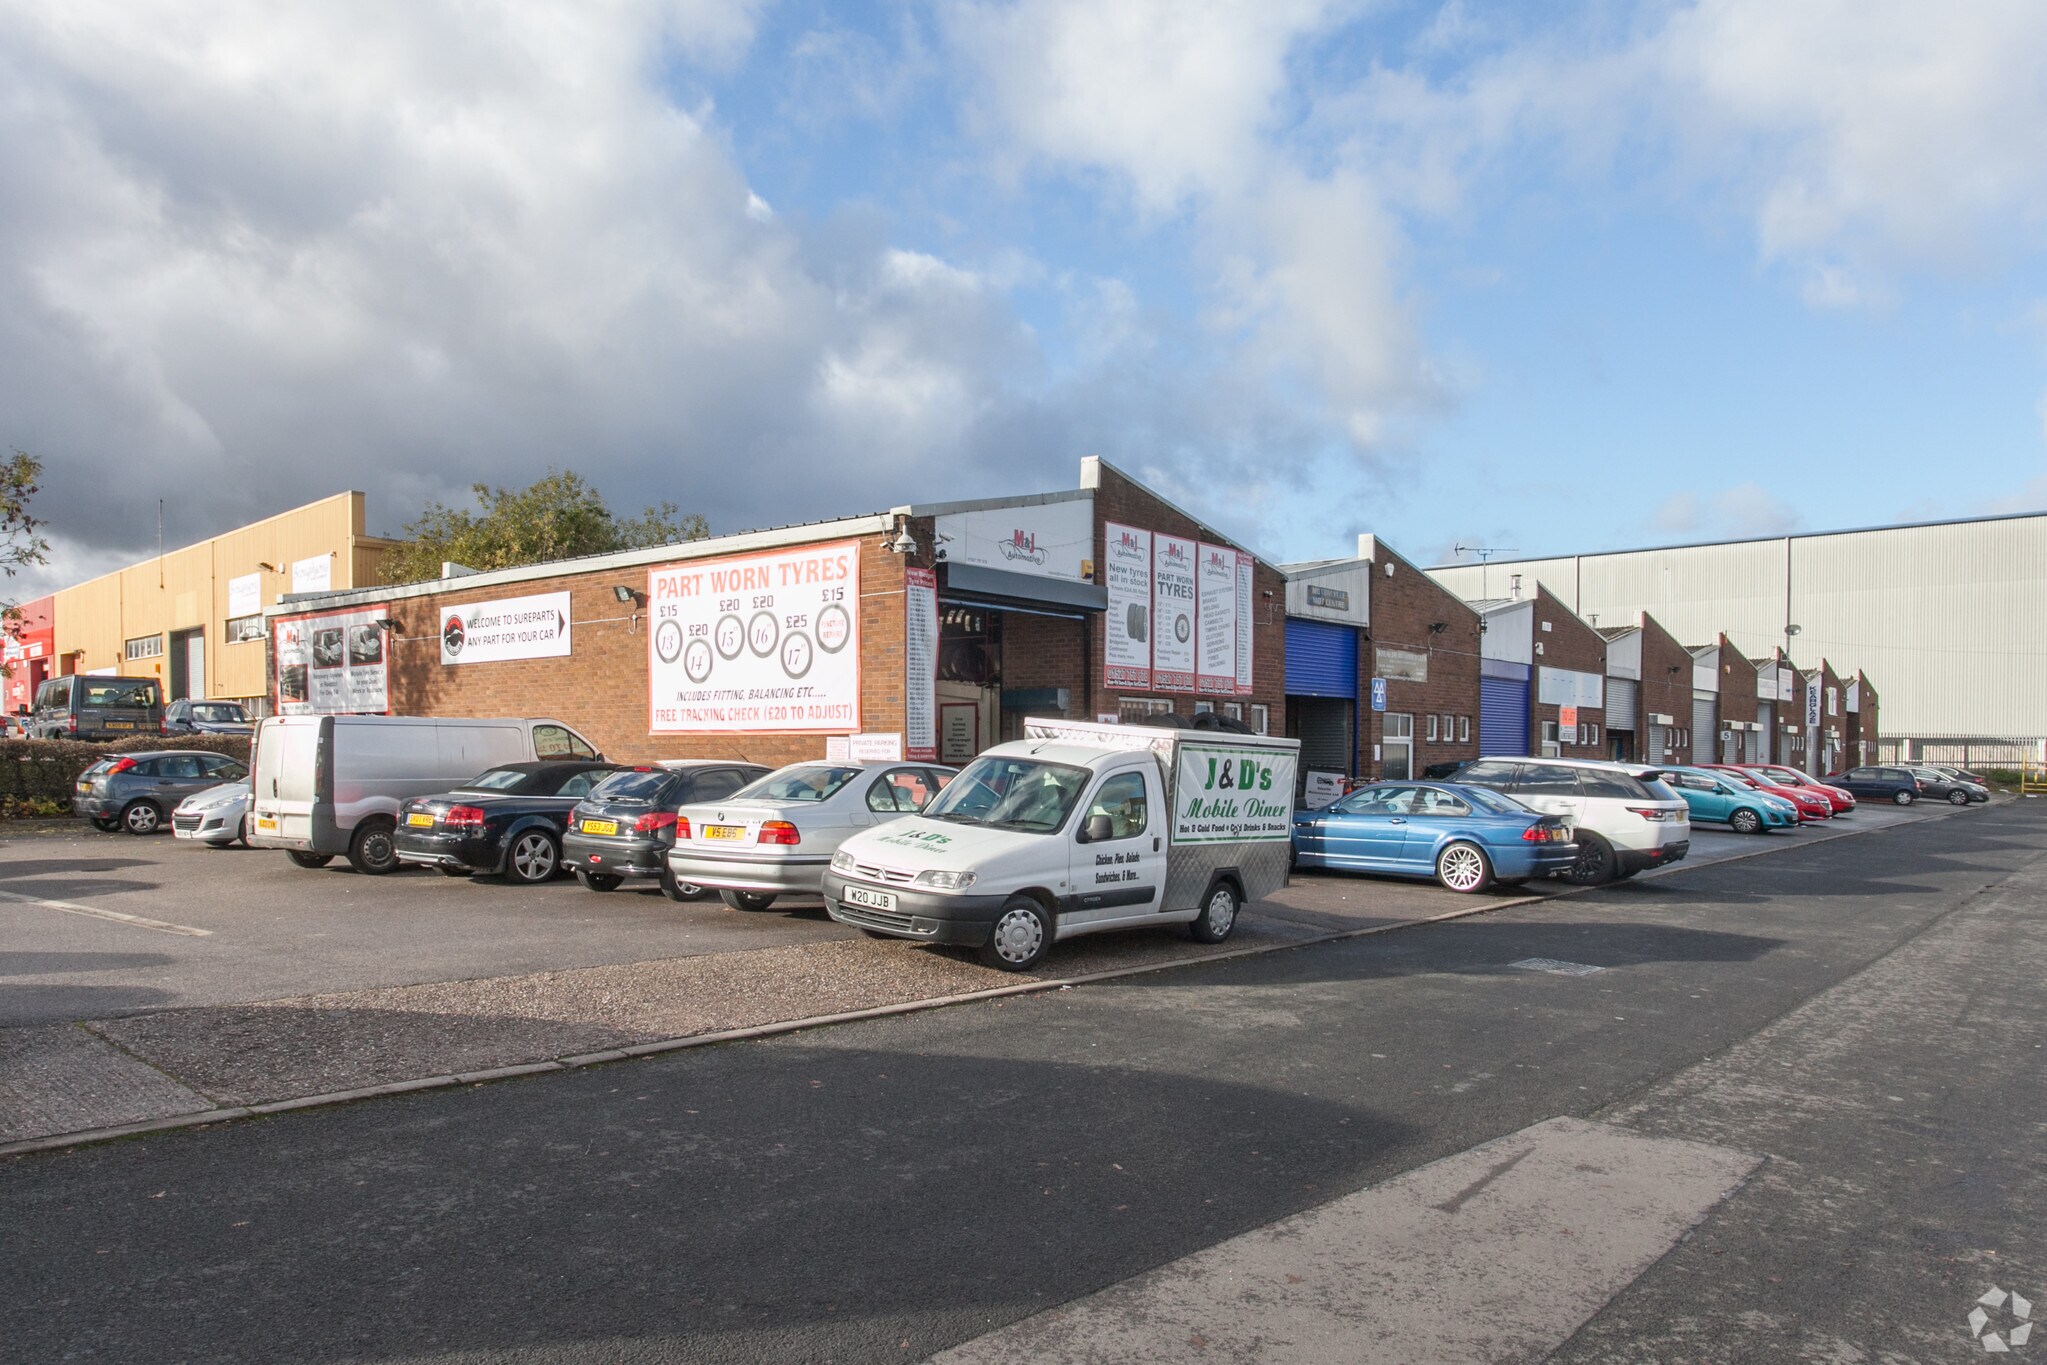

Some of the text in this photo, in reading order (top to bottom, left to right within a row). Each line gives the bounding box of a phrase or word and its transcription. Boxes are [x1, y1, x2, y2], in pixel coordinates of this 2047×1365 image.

[1007, 550, 1041, 563] Automotive
[1109, 562, 1149, 578] New tyres
[657, 555, 849, 600] PART WORN TYRES
[1109, 574, 1119, 582] all
[1130, 578, 1149, 587] stock
[1157, 572, 1193, 586] PART WORN
[821, 586, 845, 602] £15
[1157, 581, 1194, 600] TYRES
[719, 598, 740, 611] £20
[752, 595, 774, 609] £20
[659, 604, 678, 618] £15
[466, 609, 555, 629] WELCOME TO SUREPARTS
[785, 614, 808, 628] £25
[688, 623, 708, 636] £20
[467, 628, 555, 647] ANY PART FOR YOUR CAR
[676, 690, 711, 702] INCLUDES
[748, 687, 794, 700] BALANCING
[655, 702, 853, 722] FREE TRACKING CHECK (£20 TO ADJUST)
[1723, 732, 1730, 740] 5
[1181, 797, 1239, 819] Mobile
[1243, 797, 1287, 818] Diner
[1179, 822, 1286, 833] Hot & Cold Food Drinks & Snacks
[851, 889, 889, 908] W20 JJB
